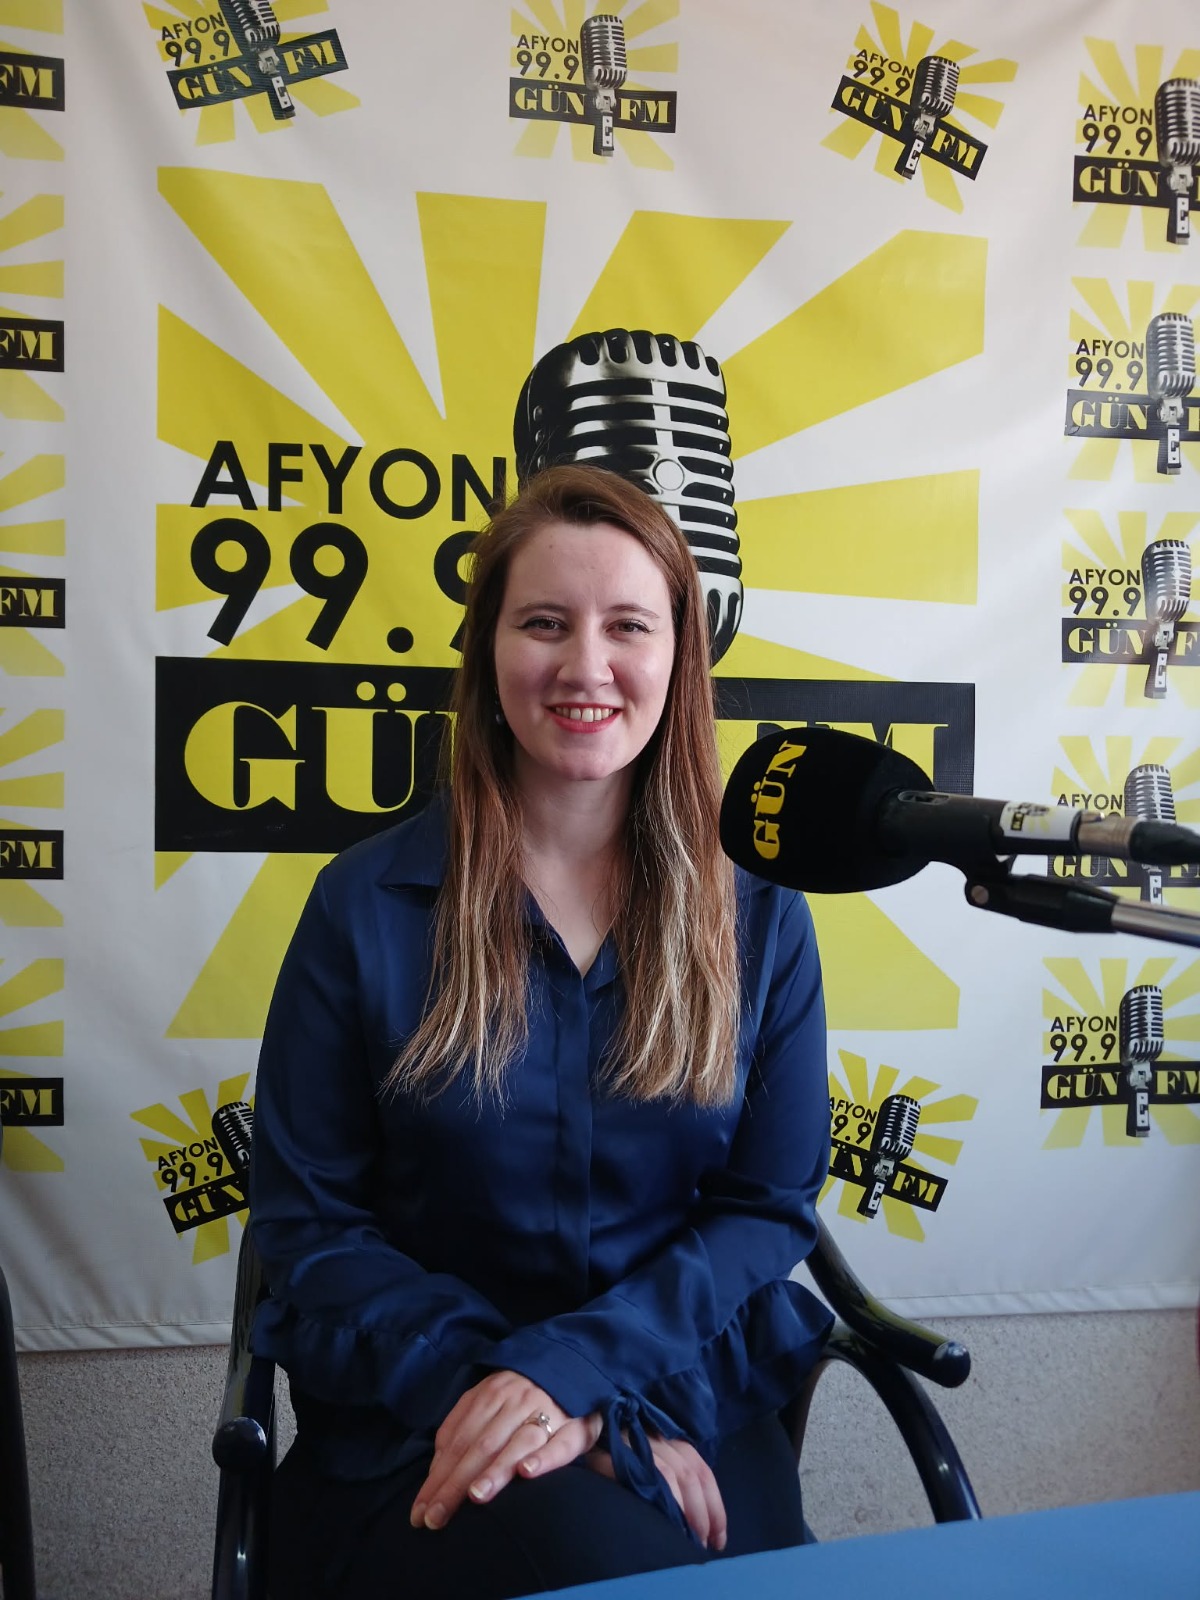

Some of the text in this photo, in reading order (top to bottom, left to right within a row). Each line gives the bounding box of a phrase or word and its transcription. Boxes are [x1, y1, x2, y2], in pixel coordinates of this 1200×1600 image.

[161, 12, 225, 41] AFYON
[165, 29, 230, 68] 99.9
[517, 34, 579, 54] AFYON
[177, 40, 338, 100] GÜN FM
[516, 50, 579, 81] 99.9
[853, 59, 911, 97] 99.9
[856, 49, 915, 80] AFYON
[515, 84, 671, 124] GÜN FM
[1083, 104, 1153, 125] AFYON
[841, 86, 979, 170] GÜN FM
[1082, 123, 1153, 157] 99.9
[1079, 162, 1160, 197] GÜN
[1076, 339, 1144, 359] AFYON
[1076, 357, 1143, 391] 99.9
[1072, 396, 1151, 430] GÜN
[190, 440, 507, 522] AFYON
[1069, 568, 1140, 586] AFYON
[1069, 586, 1141, 616] 99.9
[1068, 622, 1200, 656] GÜN F
[184, 681, 458, 813] GÜ
[751, 740, 807, 859] GÜN
[1057, 793, 1123, 811] AFYON
[1050, 1016, 1117, 1033] AFYON
[1050, 1033, 1116, 1062] 99.9
[1047, 1068, 1122, 1100] GÜN
[831, 1111, 872, 1145] 9.9
[158, 1136, 219, 1170] AFYON
[161, 1152, 224, 1193] 99.9
[892, 1171, 939, 1203] FM
